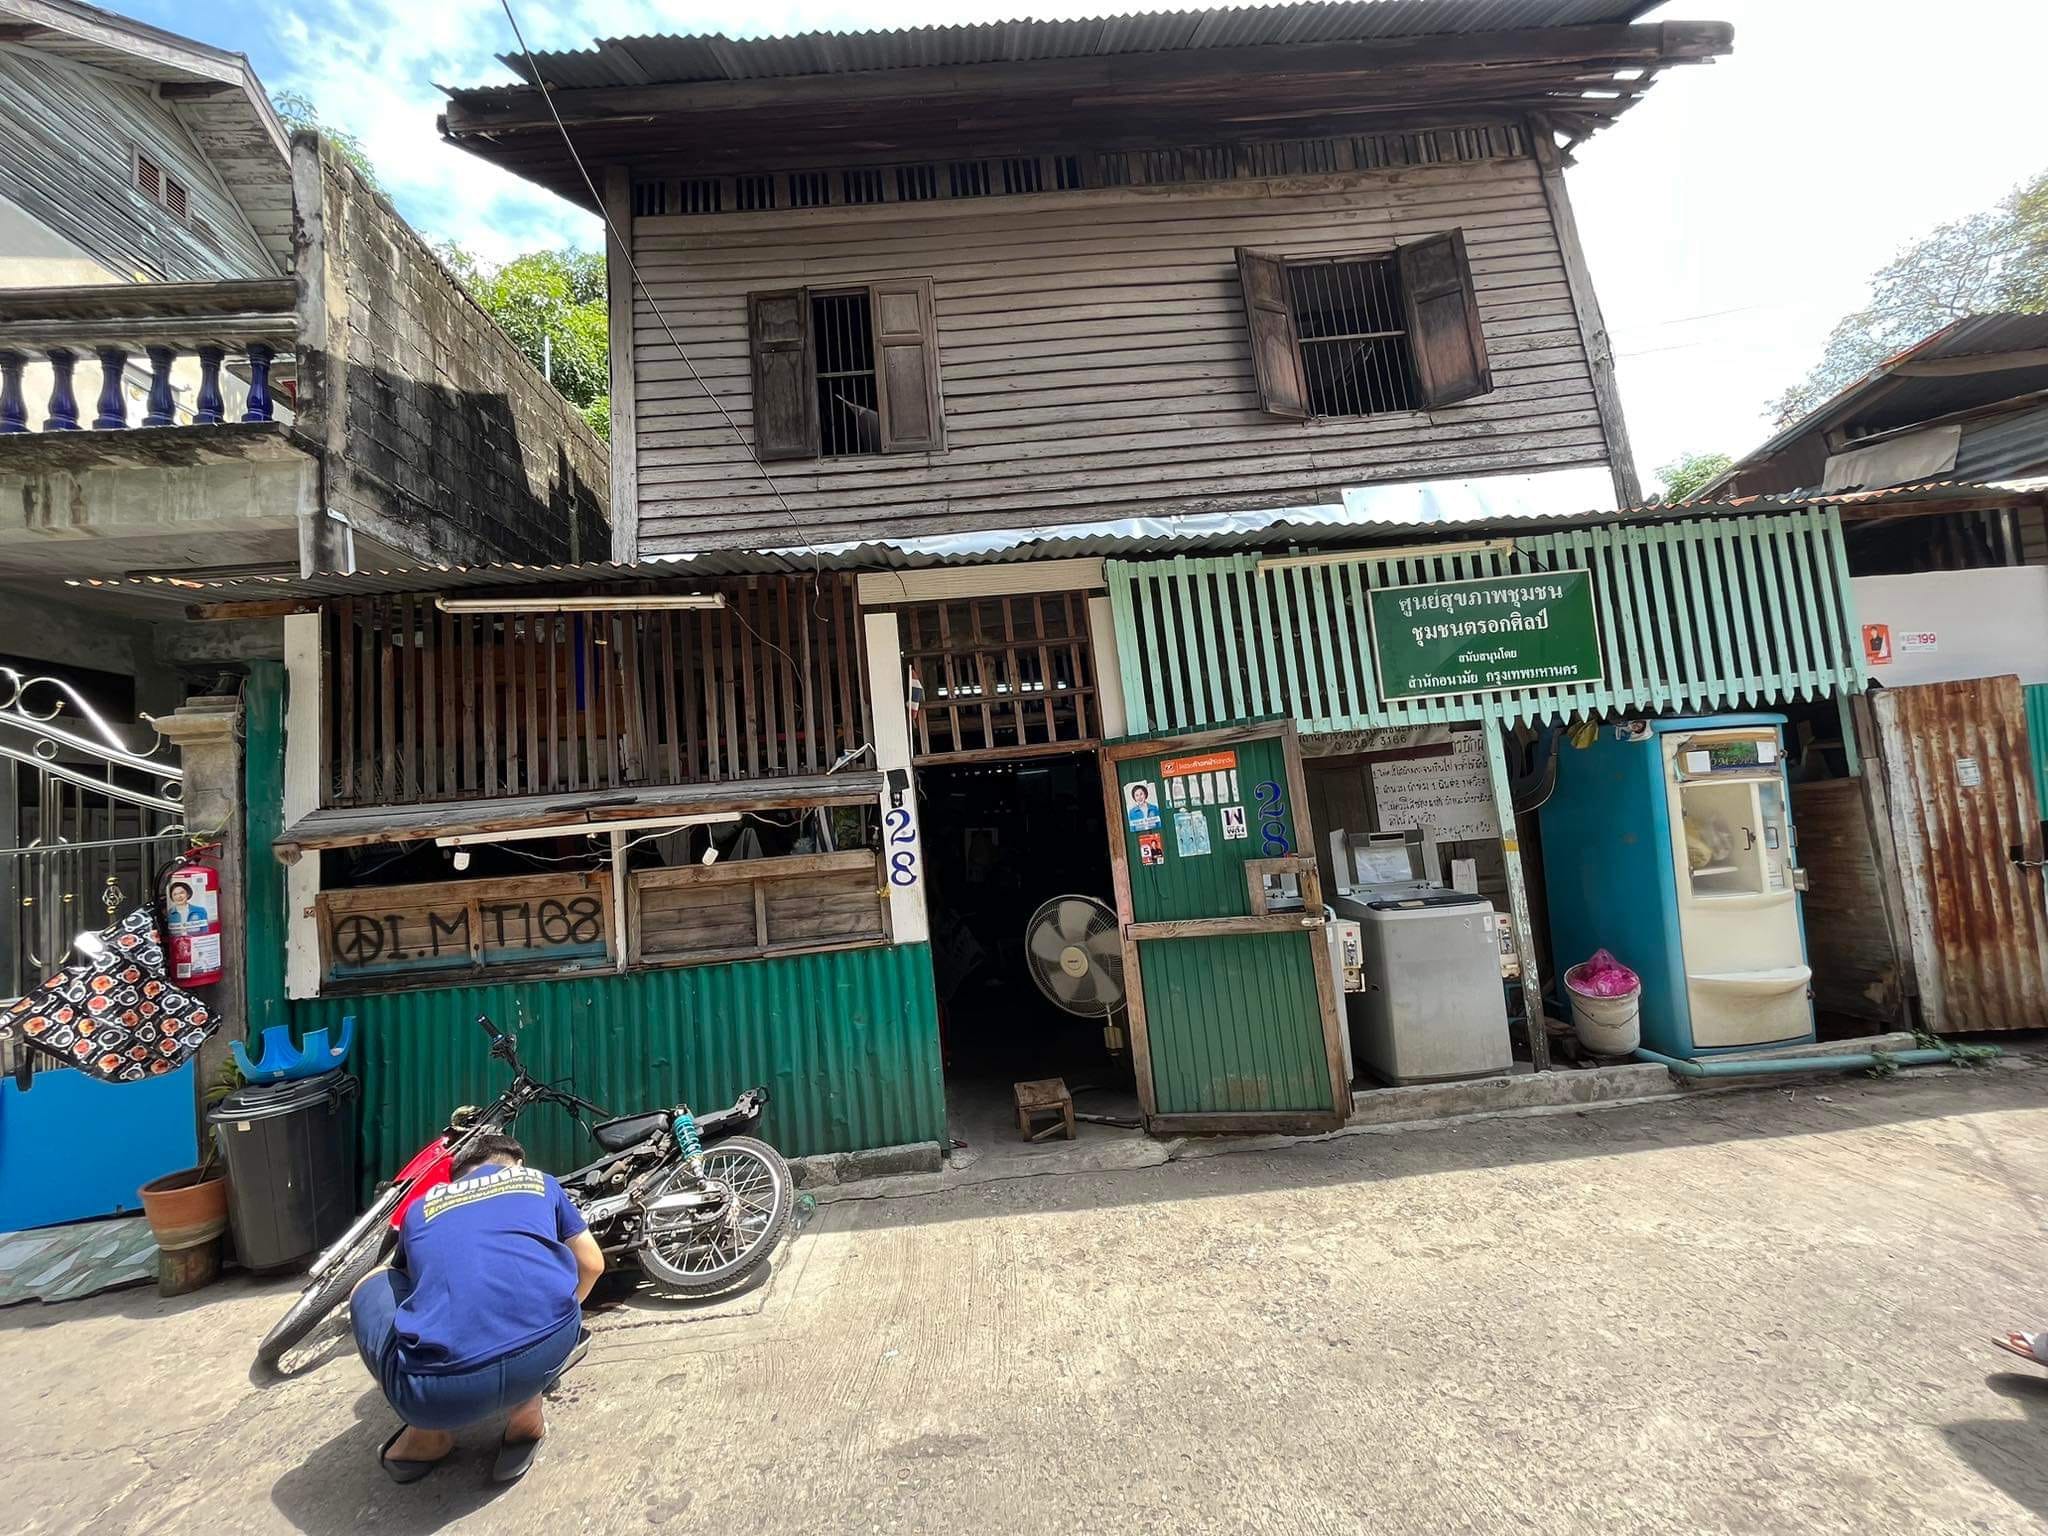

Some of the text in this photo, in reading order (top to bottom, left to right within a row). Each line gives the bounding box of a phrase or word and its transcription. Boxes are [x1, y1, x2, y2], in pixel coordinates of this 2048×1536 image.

[1398, 584, 1564, 617] ศูนย์สุขภาพชุมชน
[1411, 608, 1549, 646] ชุมชนตรอกศิลป์
[1458, 648, 1518, 665] สนับสนุนโดย
[1408, 664, 1579, 689] สำนักอนามัย กรุงเทพมหานคร
[885, 809, 917, 886] 28
[1143, 847, 1150, 856] 5
